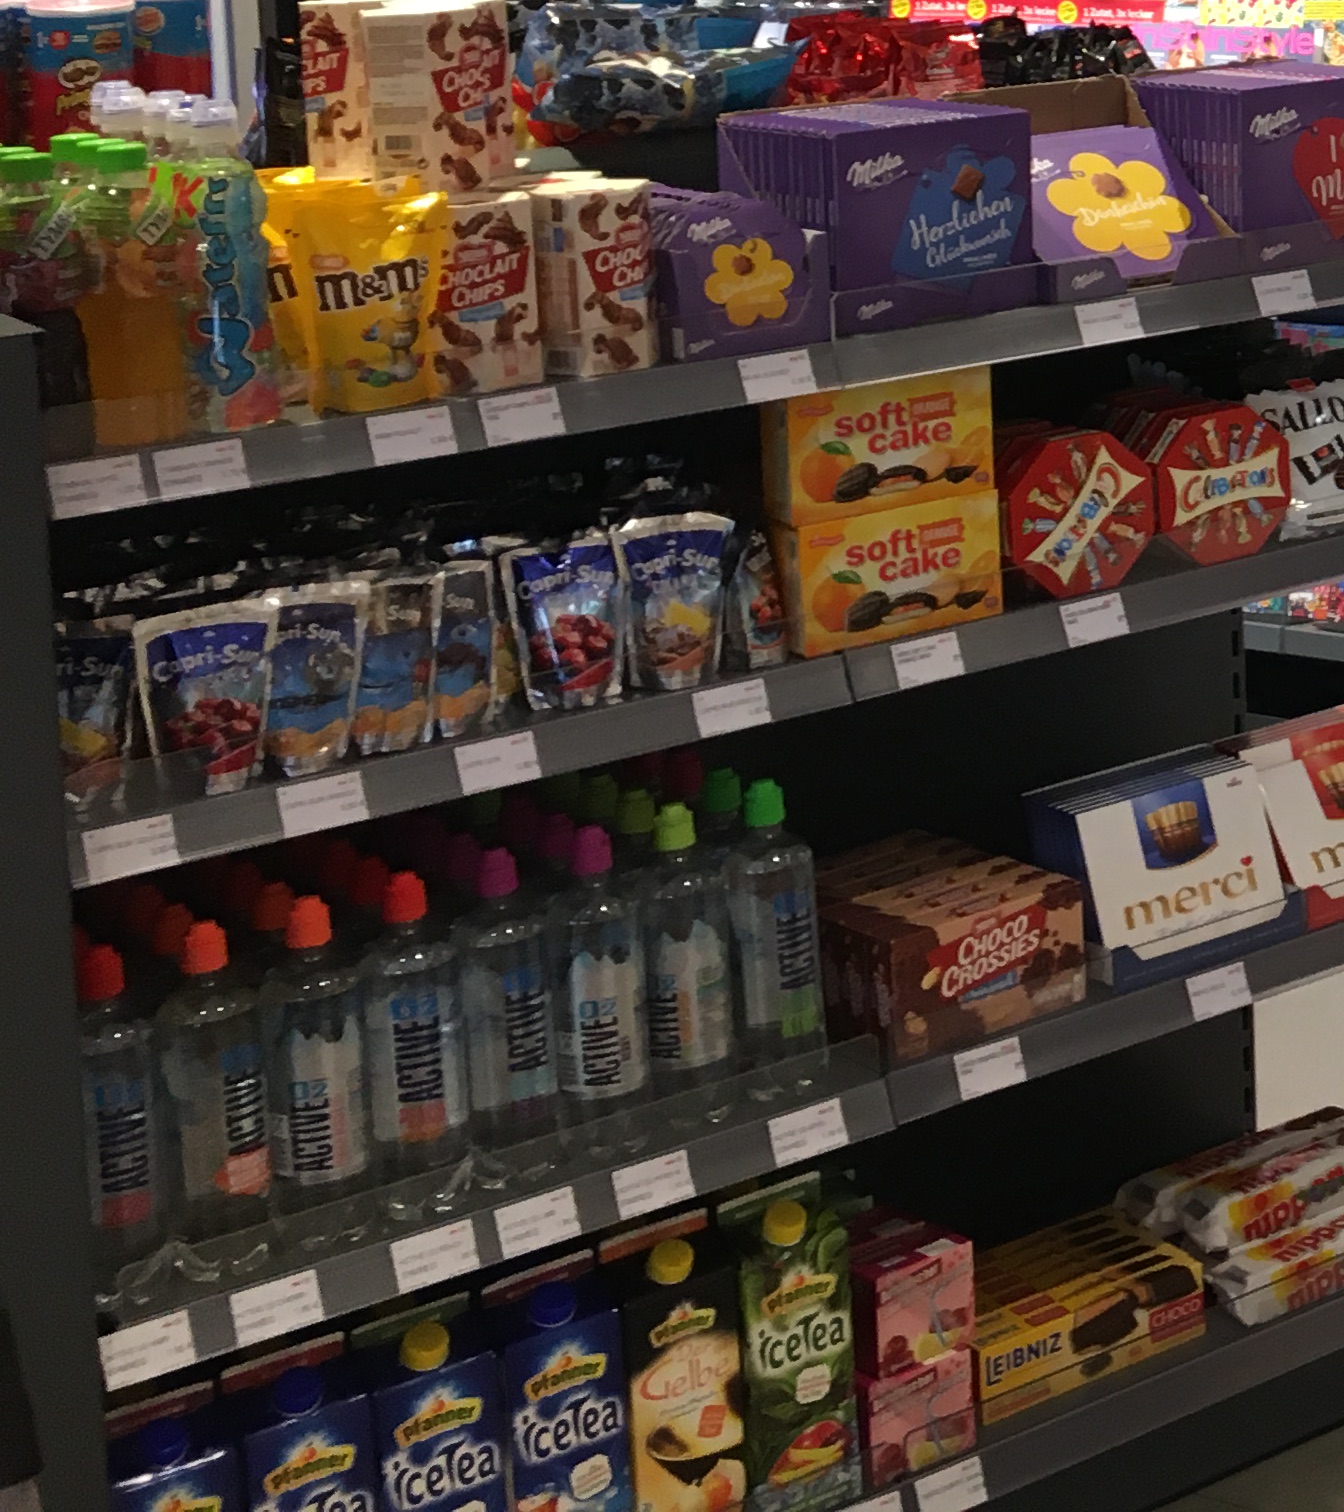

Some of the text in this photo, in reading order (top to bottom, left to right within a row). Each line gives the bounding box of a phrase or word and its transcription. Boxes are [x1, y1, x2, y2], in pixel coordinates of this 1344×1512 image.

[1128, 7, 1154, 19] lecker
[1250, 106, 1300, 138] Milka
[846, 152, 905, 187] Milka
[909, 190, 1014, 251] Herzlichen
[1076, 192, 1168, 227] Dankeschön
[452, 282, 506, 309] CHIPS
[834, 401, 906, 437] soft
[867, 416, 953, 455] cake
[631, 548, 722, 581] Capri-Sun
[845, 528, 916, 566] soft
[878, 543, 962, 582] cake
[517, 564, 615, 601] Capri-Sun
[55, 656, 124, 678] ri-Sun
[1124, 854, 1258, 930] merci
[778, 907, 818, 990] ACTIVE
[956, 913, 1030, 967] CHOCO
[940, 927, 1042, 998] CROSSIES
[504, 990, 548, 1073] ACTIVE
[649, 992, 682, 1060] ACTIVE
[393, 1014, 444, 1104] ACTIVE
[580, 1015, 622, 1087] ACTIVE
[289, 1099, 333, 1172] ACTIVE
[1149, 1299, 1202, 1328] CHOCO
[639, 1351, 732, 1401] Gelbe
[985, 1330, 1063, 1387] LEIBNIZ
